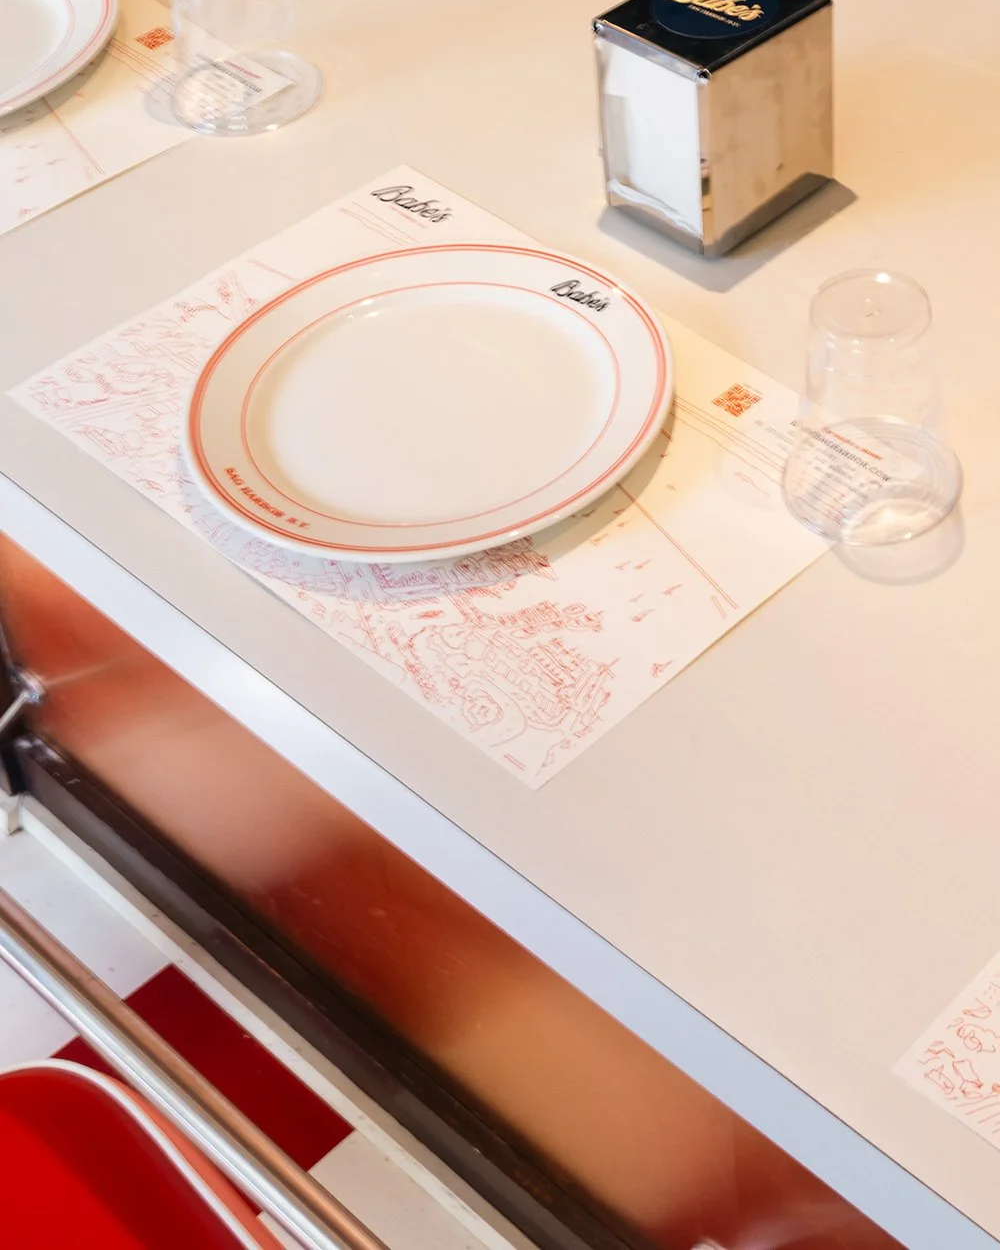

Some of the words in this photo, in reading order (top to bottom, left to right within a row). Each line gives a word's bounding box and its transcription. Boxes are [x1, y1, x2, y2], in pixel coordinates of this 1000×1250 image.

[370, 185, 453, 223] Babe's
[549, 279, 611, 312] Babe's
[240, 486, 286, 518] HARBOR
